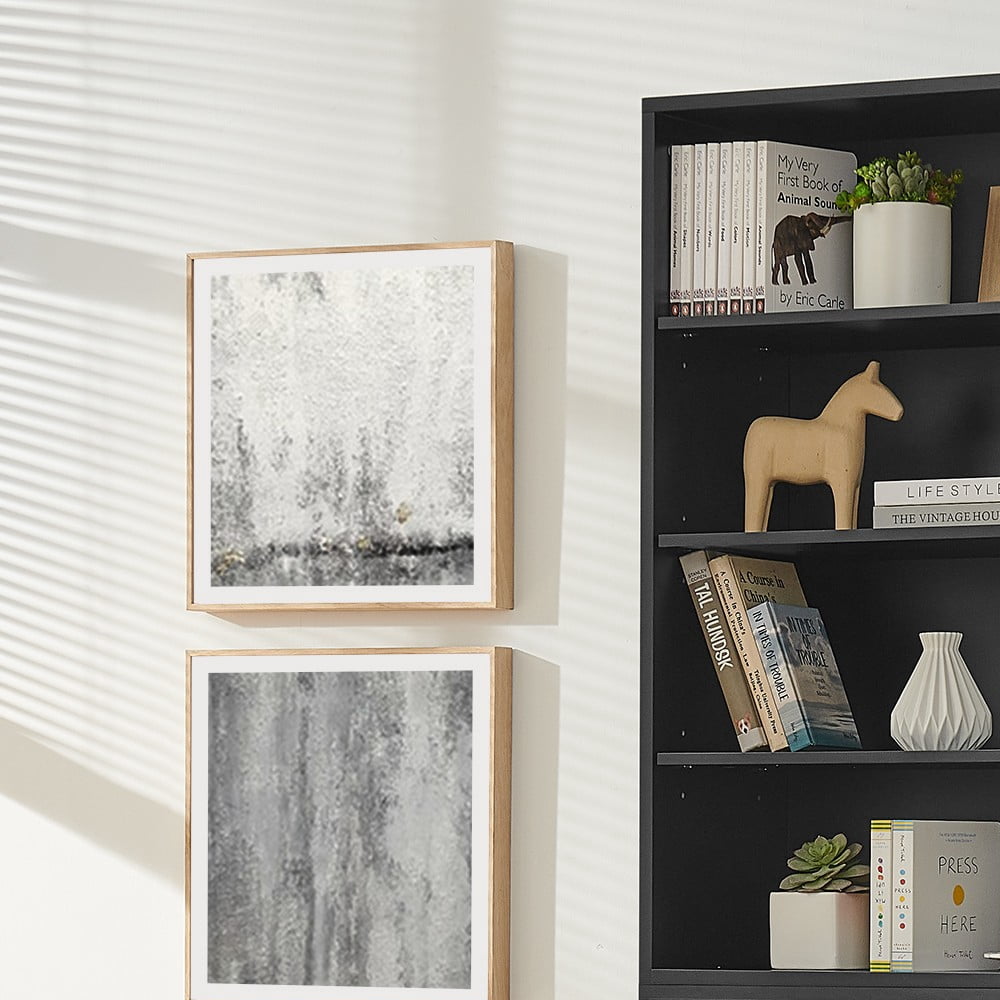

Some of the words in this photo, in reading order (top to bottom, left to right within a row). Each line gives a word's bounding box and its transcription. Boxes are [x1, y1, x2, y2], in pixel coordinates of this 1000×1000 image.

[778, 154, 793, 172] My
[794, 156, 819, 176] Very
[778, 172, 799, 188] First
[803, 175, 829, 192] Book
[832, 180, 843, 192] of
[778, 192, 811, 206] Animal
[814, 196, 842, 210] Soun
[780, 290, 792, 307] by
[796, 291, 814, 306] Eric
[818, 294, 845, 310] Carle
[892, 514, 916, 524] THE
[920, 512, 971, 523] VINTAGE
[739, 570, 745, 583] A
[747, 571, 774, 587] Course
[774, 575, 785, 588] in
[694, 582, 713, 609] TAL
[724, 579, 733, 600] Course
[753, 611, 763, 622] IN
[703, 609, 733, 671] HUNDSK
[756, 623, 772, 649] TIMES
[766, 650, 776, 661] OF
[769, 662, 789, 702] TROUBLE
[938, 856, 978, 874] PRESS
[940, 914, 977, 934] HERE
